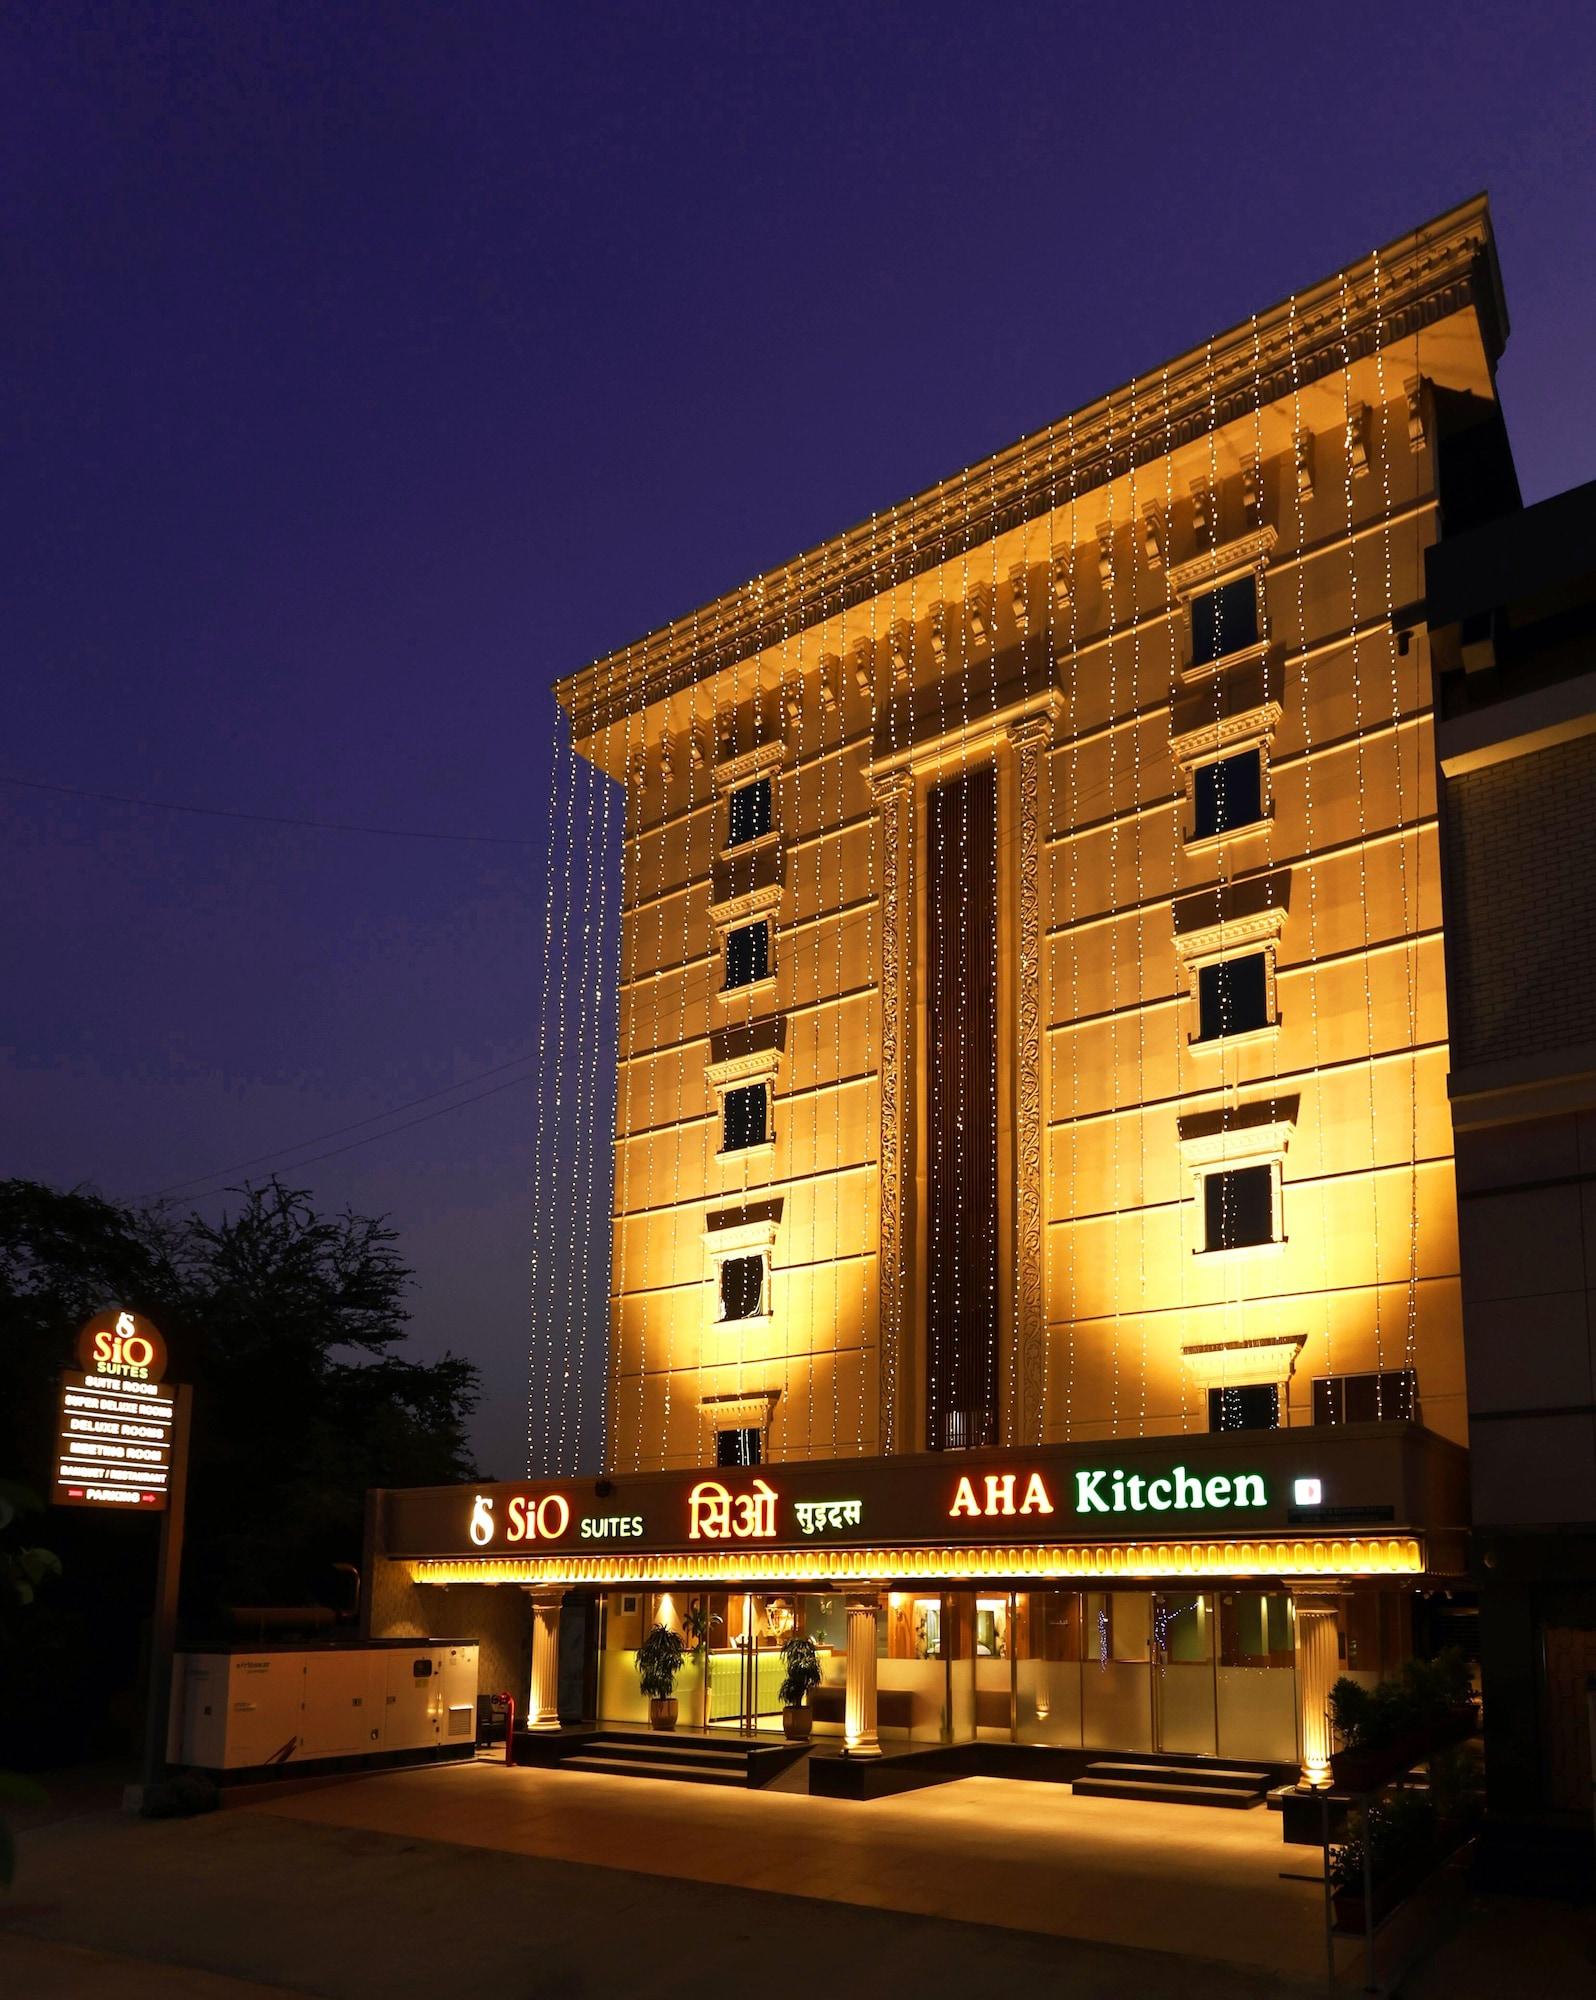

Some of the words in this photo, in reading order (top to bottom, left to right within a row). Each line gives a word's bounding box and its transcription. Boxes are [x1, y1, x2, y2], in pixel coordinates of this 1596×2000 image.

[93, 1331, 154, 1367] SiO
[97, 1361, 149, 1379] SUITES
[85, 1375, 121, 1390] SUITE
[64, 1394, 99, 1409] SUPER
[100, 1399, 138, 1414] DELUXE
[139, 1404, 173, 1418] ROOMS
[70, 1418, 119, 1434] DELUXE
[121, 1424, 164, 1439] ROOMS
[70, 1442, 125, 1458] MEETING
[126, 1448, 162, 1461] ROOM
[60, 1465, 105, 1478] BANQUET
[110, 1470, 166, 1483] RESTAURANT
[86, 1488, 140, 1503] PARKING
[948, 1473, 1054, 1517] AHA
[1075, 1466, 1268, 1514] Kitchen
[506, 1494, 570, 1542] SiO
[580, 1516, 644, 1539] SUITES
[687, 1478, 779, 1540] सिओ
